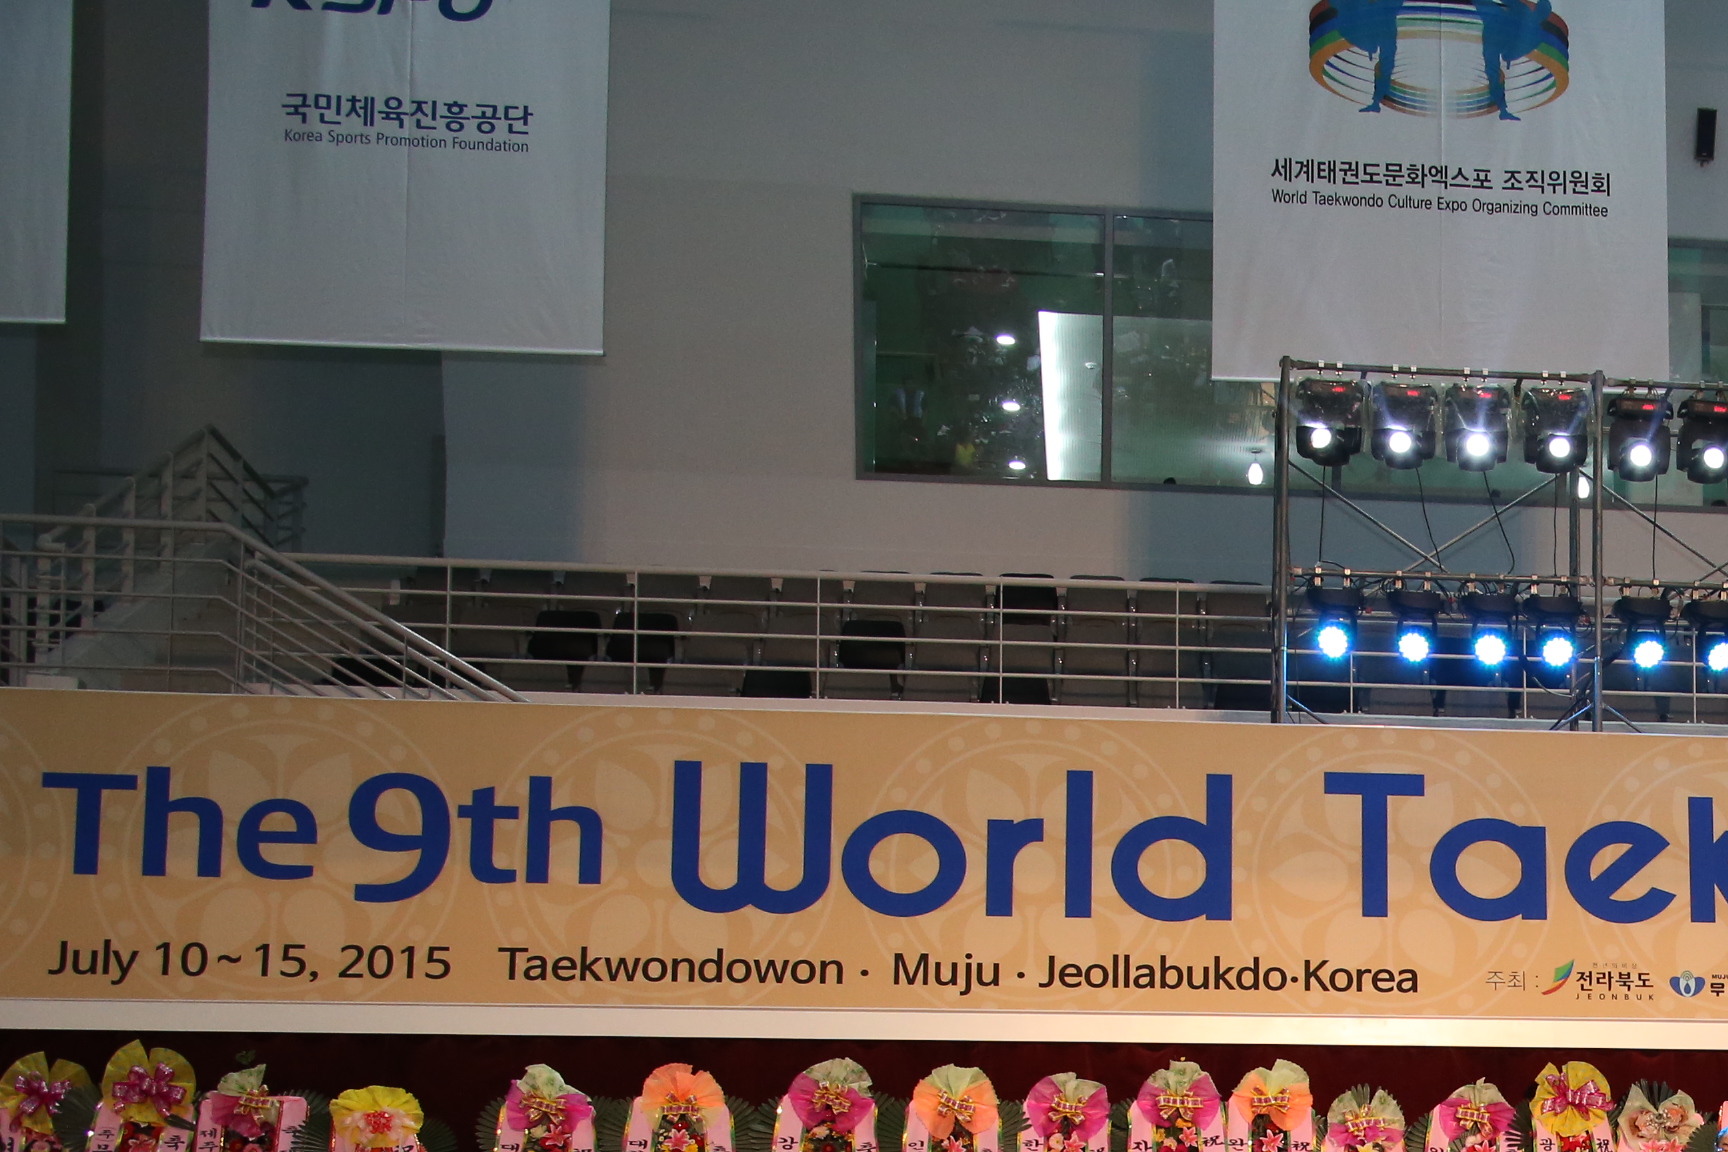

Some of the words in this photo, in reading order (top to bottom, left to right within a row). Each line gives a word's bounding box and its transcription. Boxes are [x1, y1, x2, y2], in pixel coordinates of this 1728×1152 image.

[282, 93, 533, 135] 국민체육진흥공단
[285, 129, 322, 142] Korea
[328, 130, 371, 146] Sports
[376, 132, 446, 148] Promotion
[452, 137, 529, 152] Foundation
[1271, 157, 1493, 189] 세계태권도문화엑스포
[1502, 169, 1611, 197] 조직위원회
[1272, 189, 1307, 204] World
[1312, 191, 1383, 208] Taekwondo
[1388, 194, 1432, 210] Culture
[1437, 197, 1467, 213] Expo
[1472, 198, 1538, 217] Organizing
[1543, 201, 1608, 217] Committee
[42, 767, 318, 881] The
[348, 772, 604, 904] 9th
[671, 760, 1232, 923] World
[47, 939, 138, 985] July
[154, 941, 320, 983] 10~15,
[339, 944, 451, 981] 2015
[499, 946, 844, 985] Taekwondowon
[894, 952, 1001, 997] Muju
[1485, 970, 1526, 991] 주최
[1575, 970, 1654, 991] 전라북도
[1575, 993, 1655, 1001] JEONBUK
